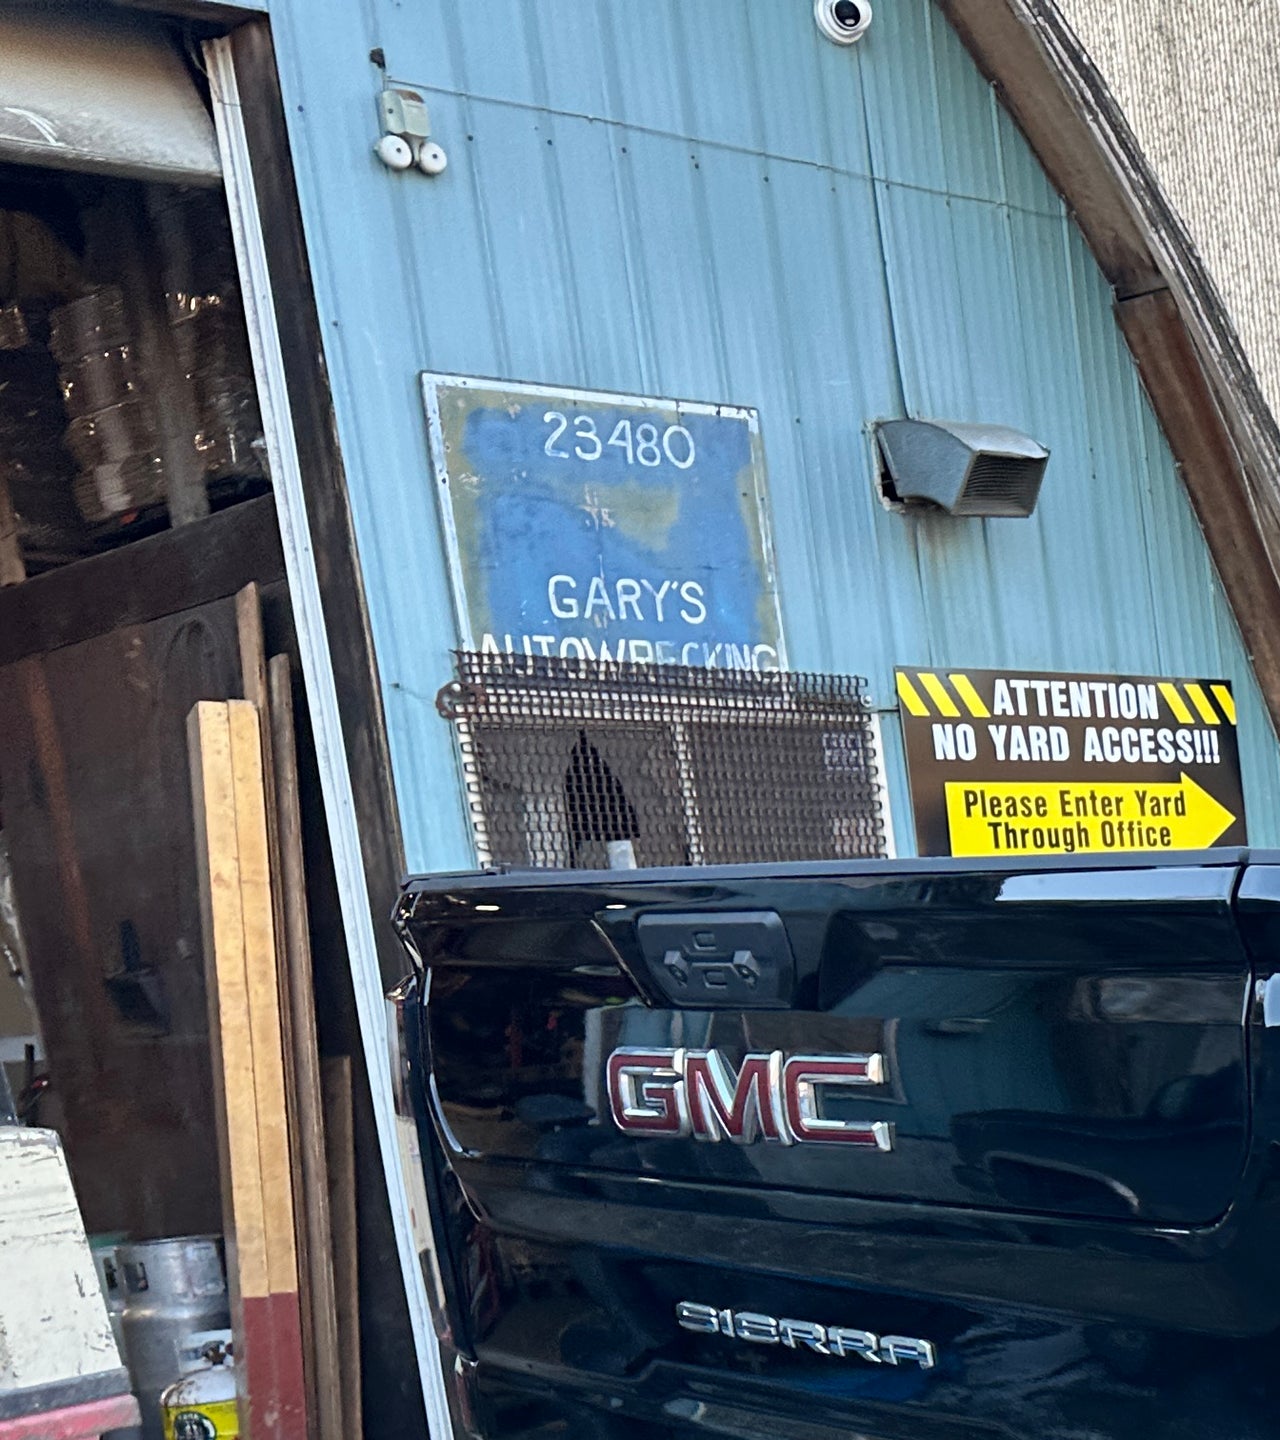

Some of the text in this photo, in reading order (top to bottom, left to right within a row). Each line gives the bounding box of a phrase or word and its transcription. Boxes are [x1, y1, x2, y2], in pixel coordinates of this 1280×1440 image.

[543, 411, 696, 469] 23480
[548, 574, 706, 624] GARY'S
[993, 679, 1159, 720] ATTENTION
[932, 723, 1221, 764] NO YARD ACCESS!!!
[963, 790, 1187, 818] Please Enter Yard
[987, 820, 1172, 852] Through Office
[607, 1047, 896, 1151] GMC
[676, 1301, 936, 1369] SIERRA
